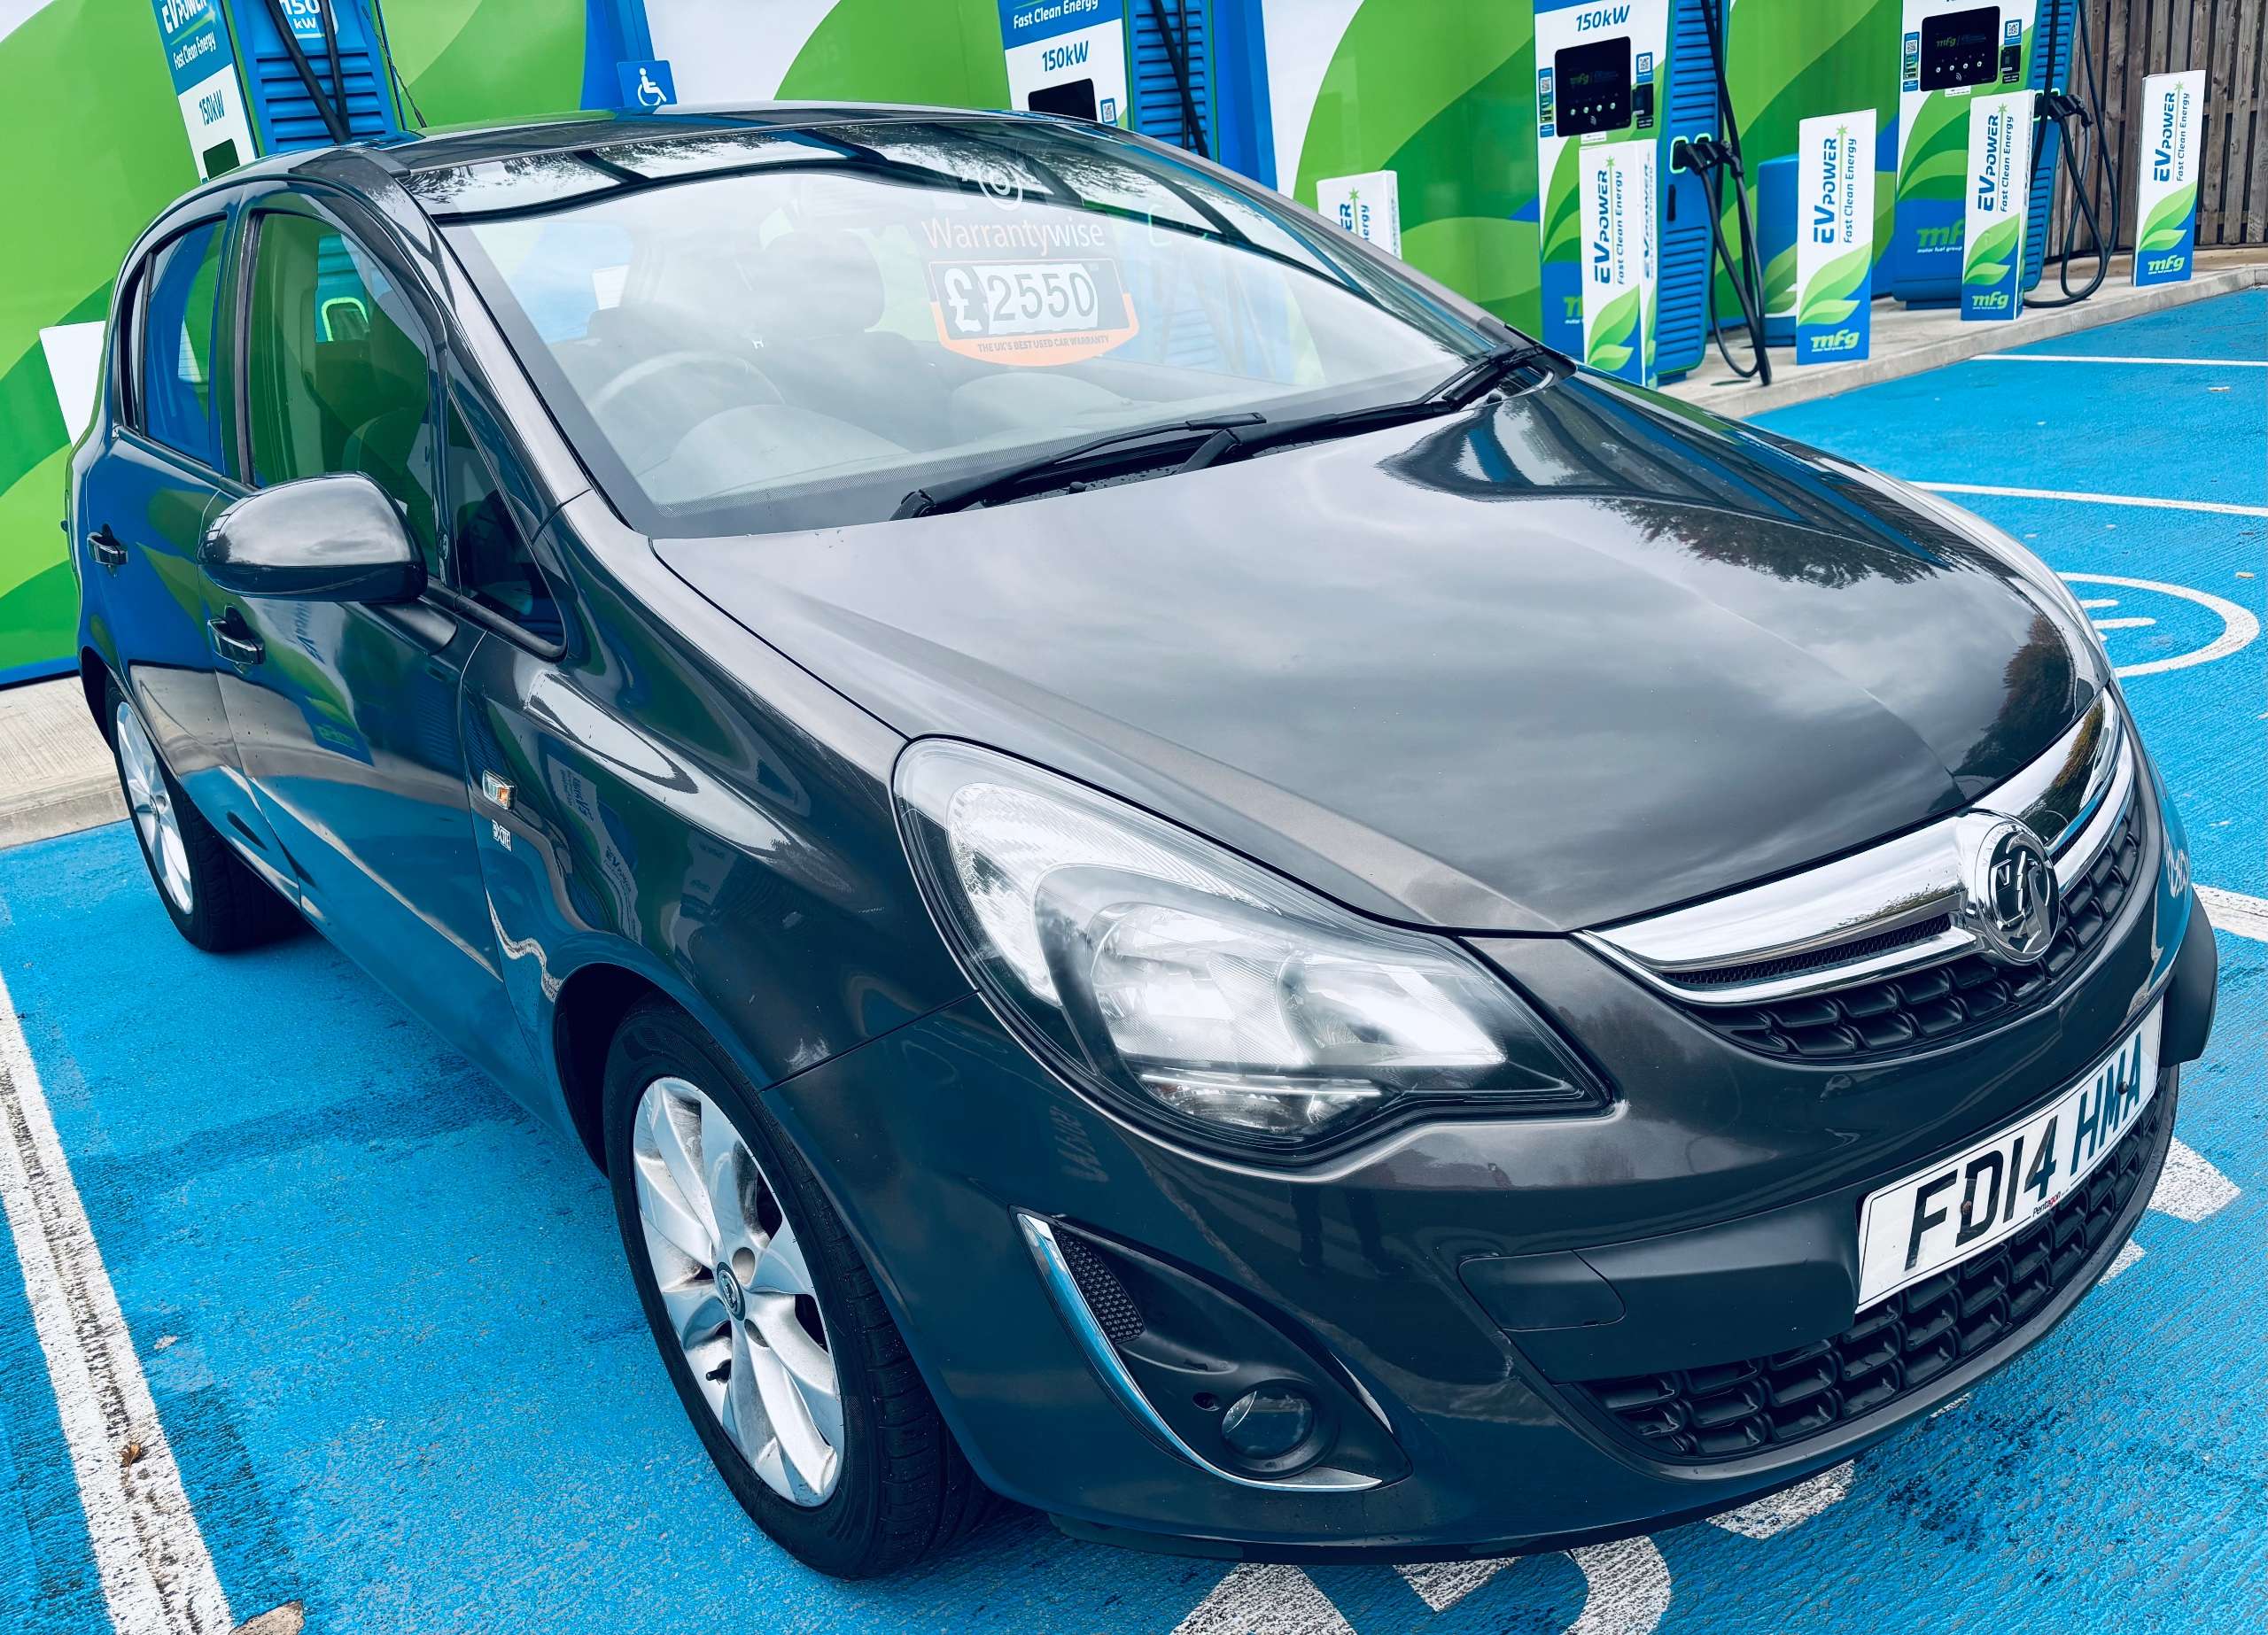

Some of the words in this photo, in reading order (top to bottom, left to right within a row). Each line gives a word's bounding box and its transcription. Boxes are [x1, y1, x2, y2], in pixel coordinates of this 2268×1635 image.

[293, 18, 316, 29] kW
[1013, 14, 1034, 29] Fast
[1034, 6, 1061, 23] Clean
[1576, 4, 1630, 32] 150kW
[173, 52, 186, 71] Fast
[183, 44, 198, 64] Clean
[196, 31, 216, 55] Energy
[1042, 41, 1089, 73] 150kW
[199, 89, 225, 126] 150kW
[2162, 92, 2176, 150] POWER
[2179, 93, 2190, 128] Energy
[1986, 114, 2000, 179] POWER
[2004, 116, 2015, 156] Energy
[2178, 130, 2186, 159] Clean
[1822, 137, 1837, 205] POWER
[1845, 138, 1857, 181] Energy
[2002, 158, 2011, 190] Clean
[2154, 149, 2172, 182] EV
[1597, 169, 1610, 243] POWER
[1845, 183, 1854, 217] Clean
[1977, 174, 1996, 212] EV
[2000, 190, 2008, 213] Fast
[921, 216, 1107, 256] Warrantywise
[1361, 205, 1371, 241] ergy
[1616, 221, 1625, 254] Clean
[1813, 205, 1836, 244] EV
[1843, 219, 1853, 244] Fast
[1916, 218, 1965, 247] mf
[1594, 241, 1611, 284] EV
[2148, 255, 2185, 273] mfg
[1971, 291, 2009, 310] mfg
[977, 344, 994, 353] THE
[1014, 340, 1032, 350] BEST
[1033, 338, 1053, 349] USED
[1053, 337, 1070, 347] CAR
[1070, 335, 1109, 345] WARRANTY
[1810, 329, 1860, 350] mfg
[1904, 1115, 2059, 1272] FD14
[2070, 1030, 2142, 1177] HMA
